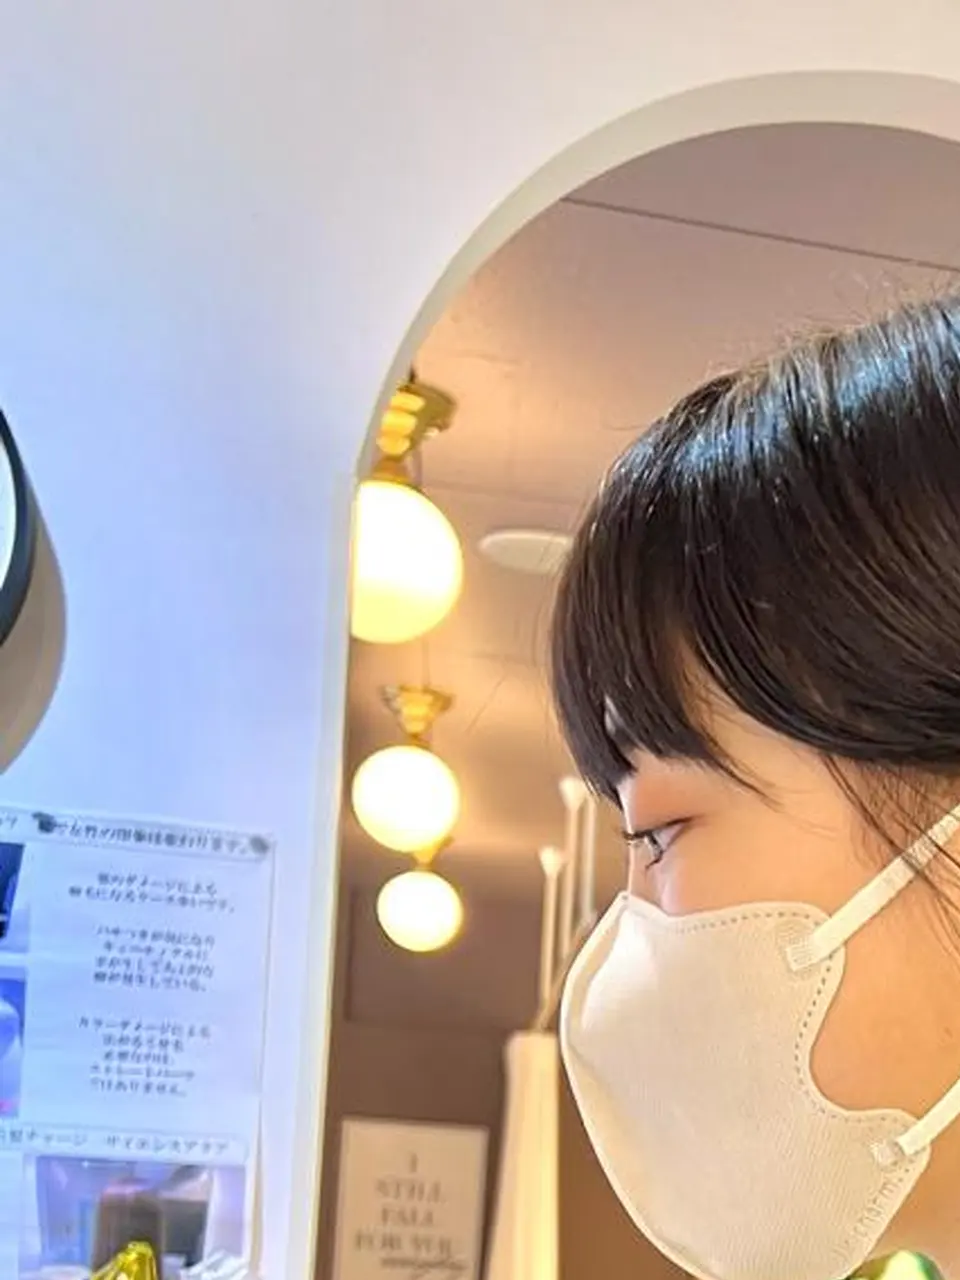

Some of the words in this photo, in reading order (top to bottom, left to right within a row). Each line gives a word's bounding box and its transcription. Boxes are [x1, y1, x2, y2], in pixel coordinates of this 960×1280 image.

[42, 818, 248, 854] で女性の印象は変わります。
